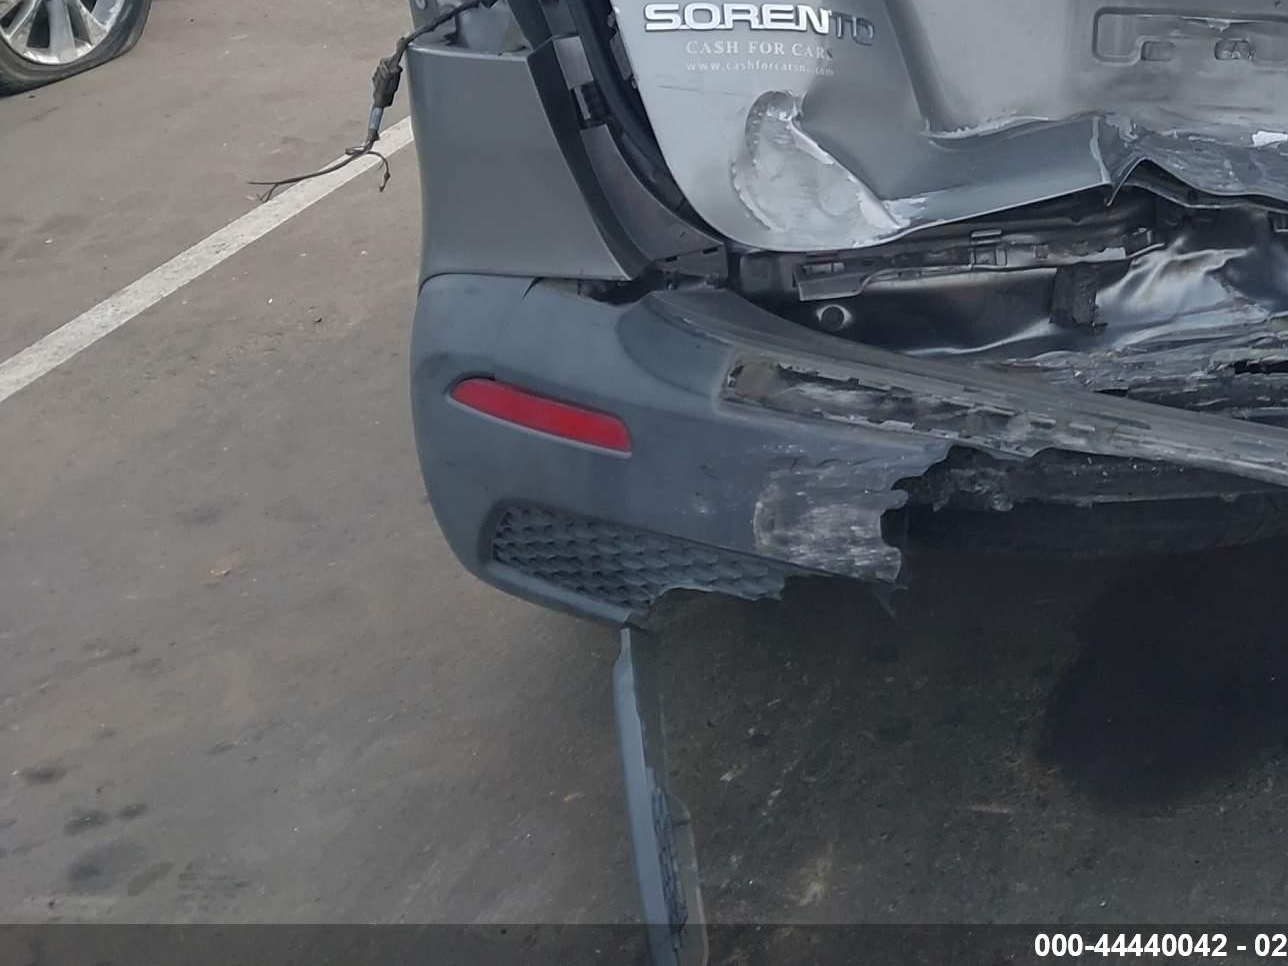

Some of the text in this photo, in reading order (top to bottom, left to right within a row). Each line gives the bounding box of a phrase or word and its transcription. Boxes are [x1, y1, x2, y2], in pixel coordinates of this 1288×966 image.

[644, 2, 876, 46] SORENTO
[685, 41, 739, 55] CASH
[748, 41, 785, 55] FOR
